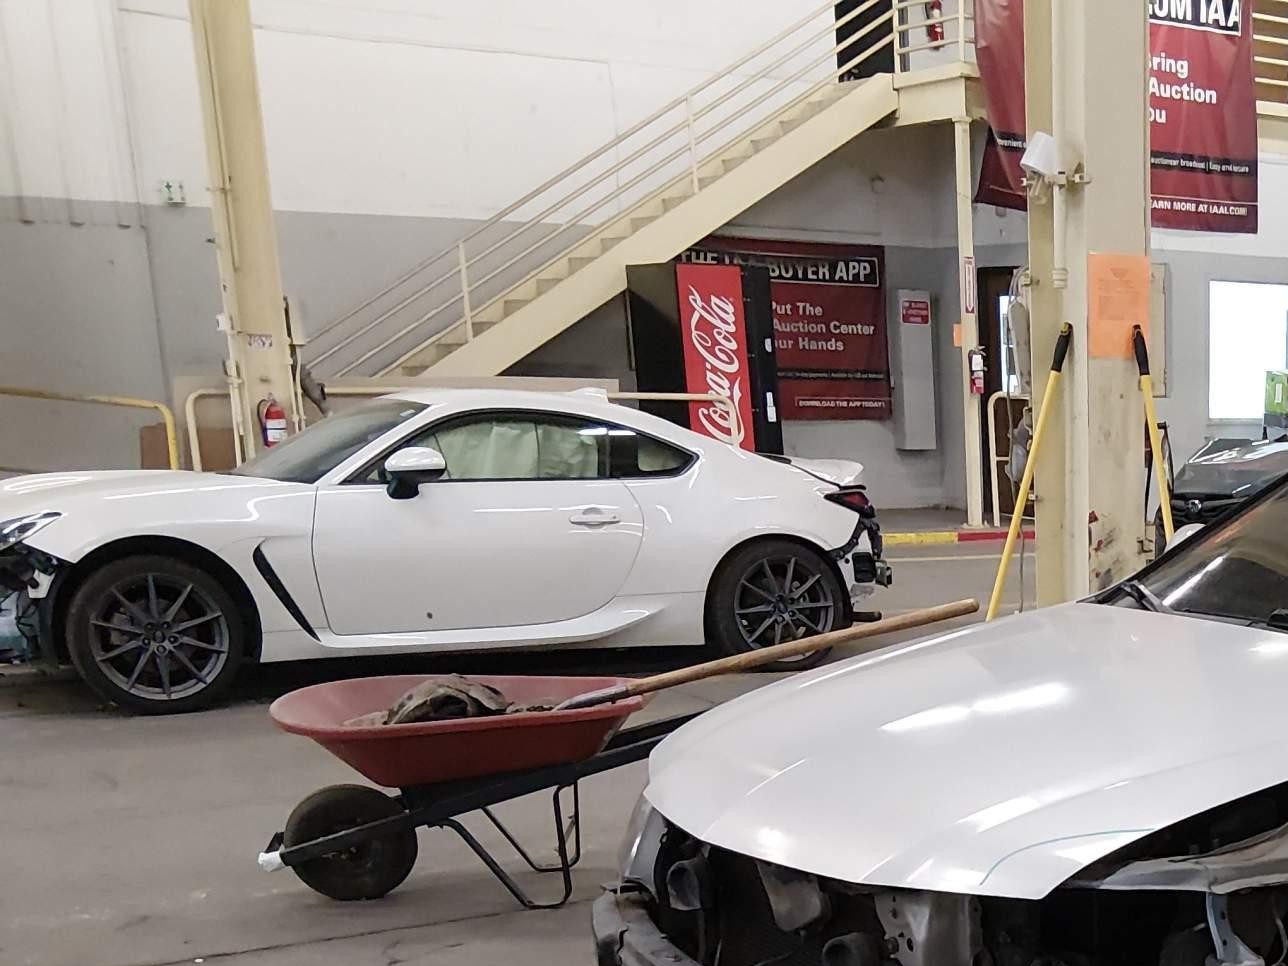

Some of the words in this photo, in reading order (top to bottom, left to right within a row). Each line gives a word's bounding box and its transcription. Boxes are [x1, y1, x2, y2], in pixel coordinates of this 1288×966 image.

[1149, 0, 1192, 21] OM
[1200, 0, 1240, 27] IAA
[1149, 52, 1188, 79] ring
[1149, 77, 1217, 104] Auction
[1150, 200, 1171, 210] ARN
[1173, 201, 1197, 212] MORE
[1198, 204, 1208, 213] AT
[835, 261, 871, 282] APP
[796, 302, 823, 316] The
[773, 318, 826, 333] Auction
[830, 321, 875, 335] Center
[774, 339, 793, 349] ur
[799, 337, 845, 351] Hands
